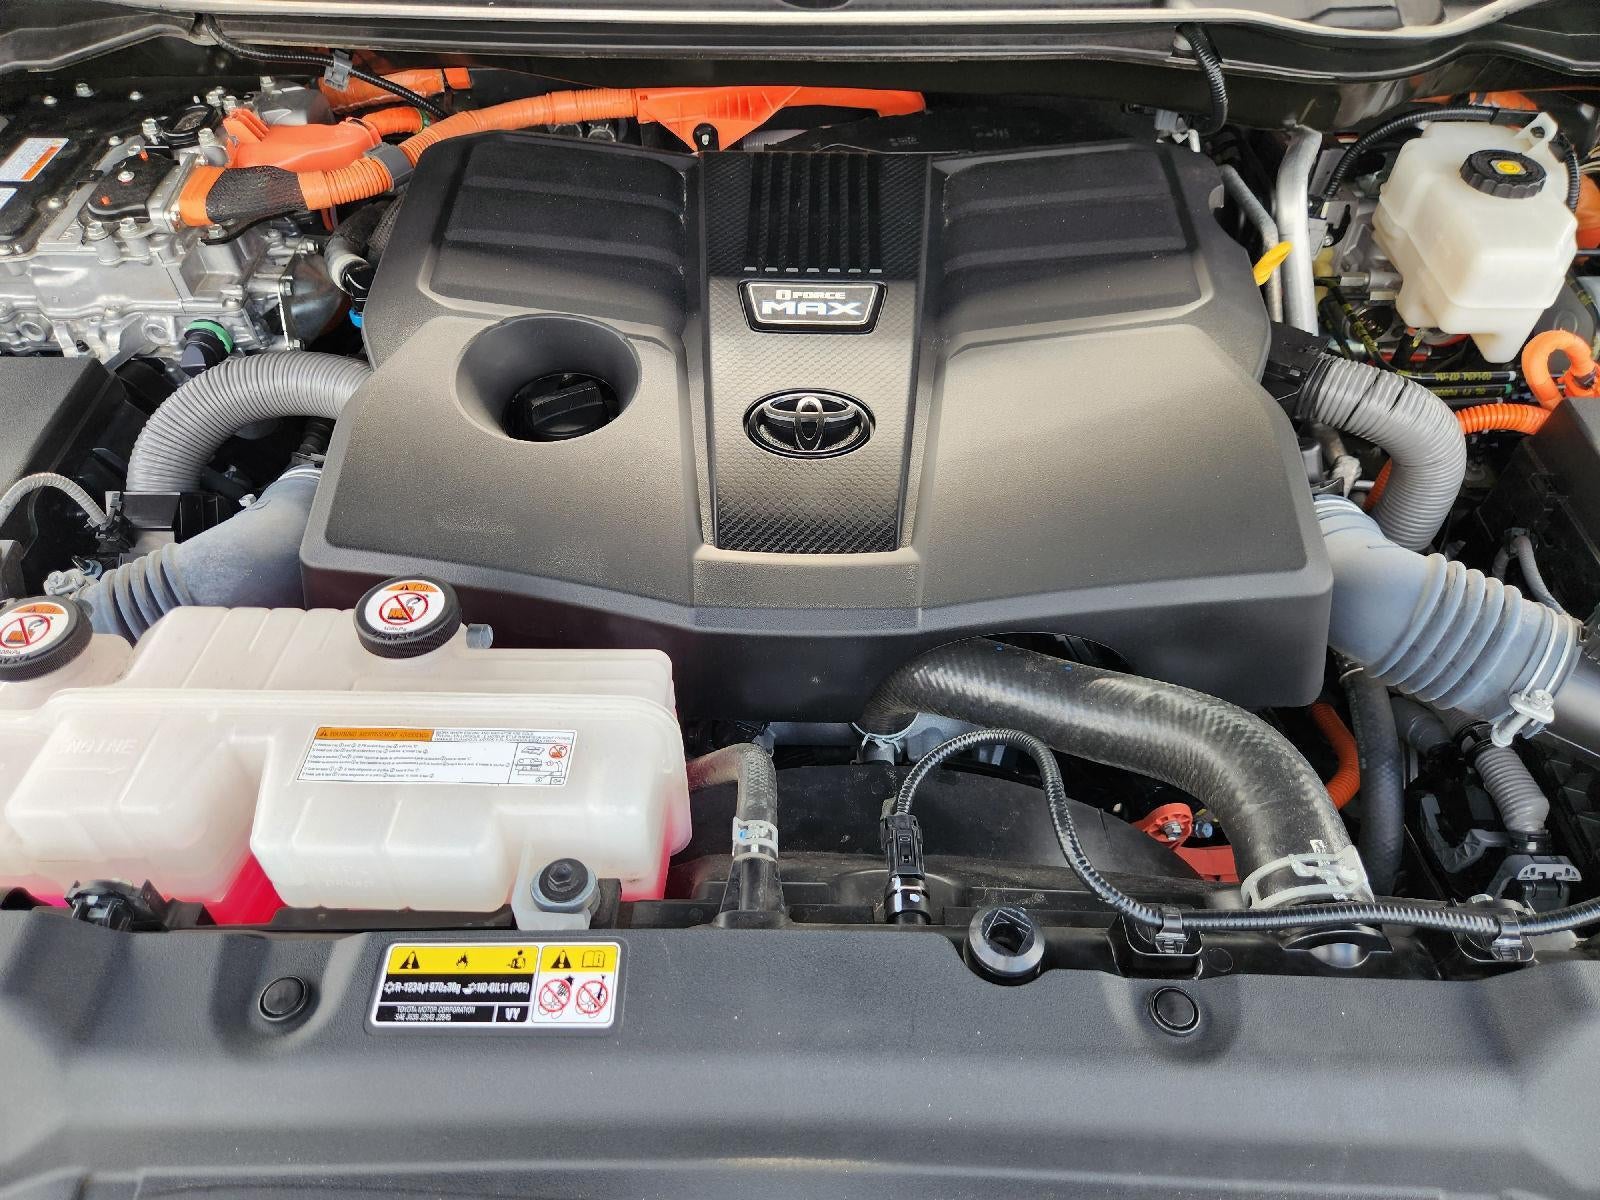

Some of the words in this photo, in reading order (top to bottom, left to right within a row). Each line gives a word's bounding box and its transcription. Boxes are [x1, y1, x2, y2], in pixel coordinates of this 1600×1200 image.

[761, 301, 862, 316] MAX
[396, 1005, 417, 1013] TOYOTA
[437, 1006, 476, 1014] CORPORATION
